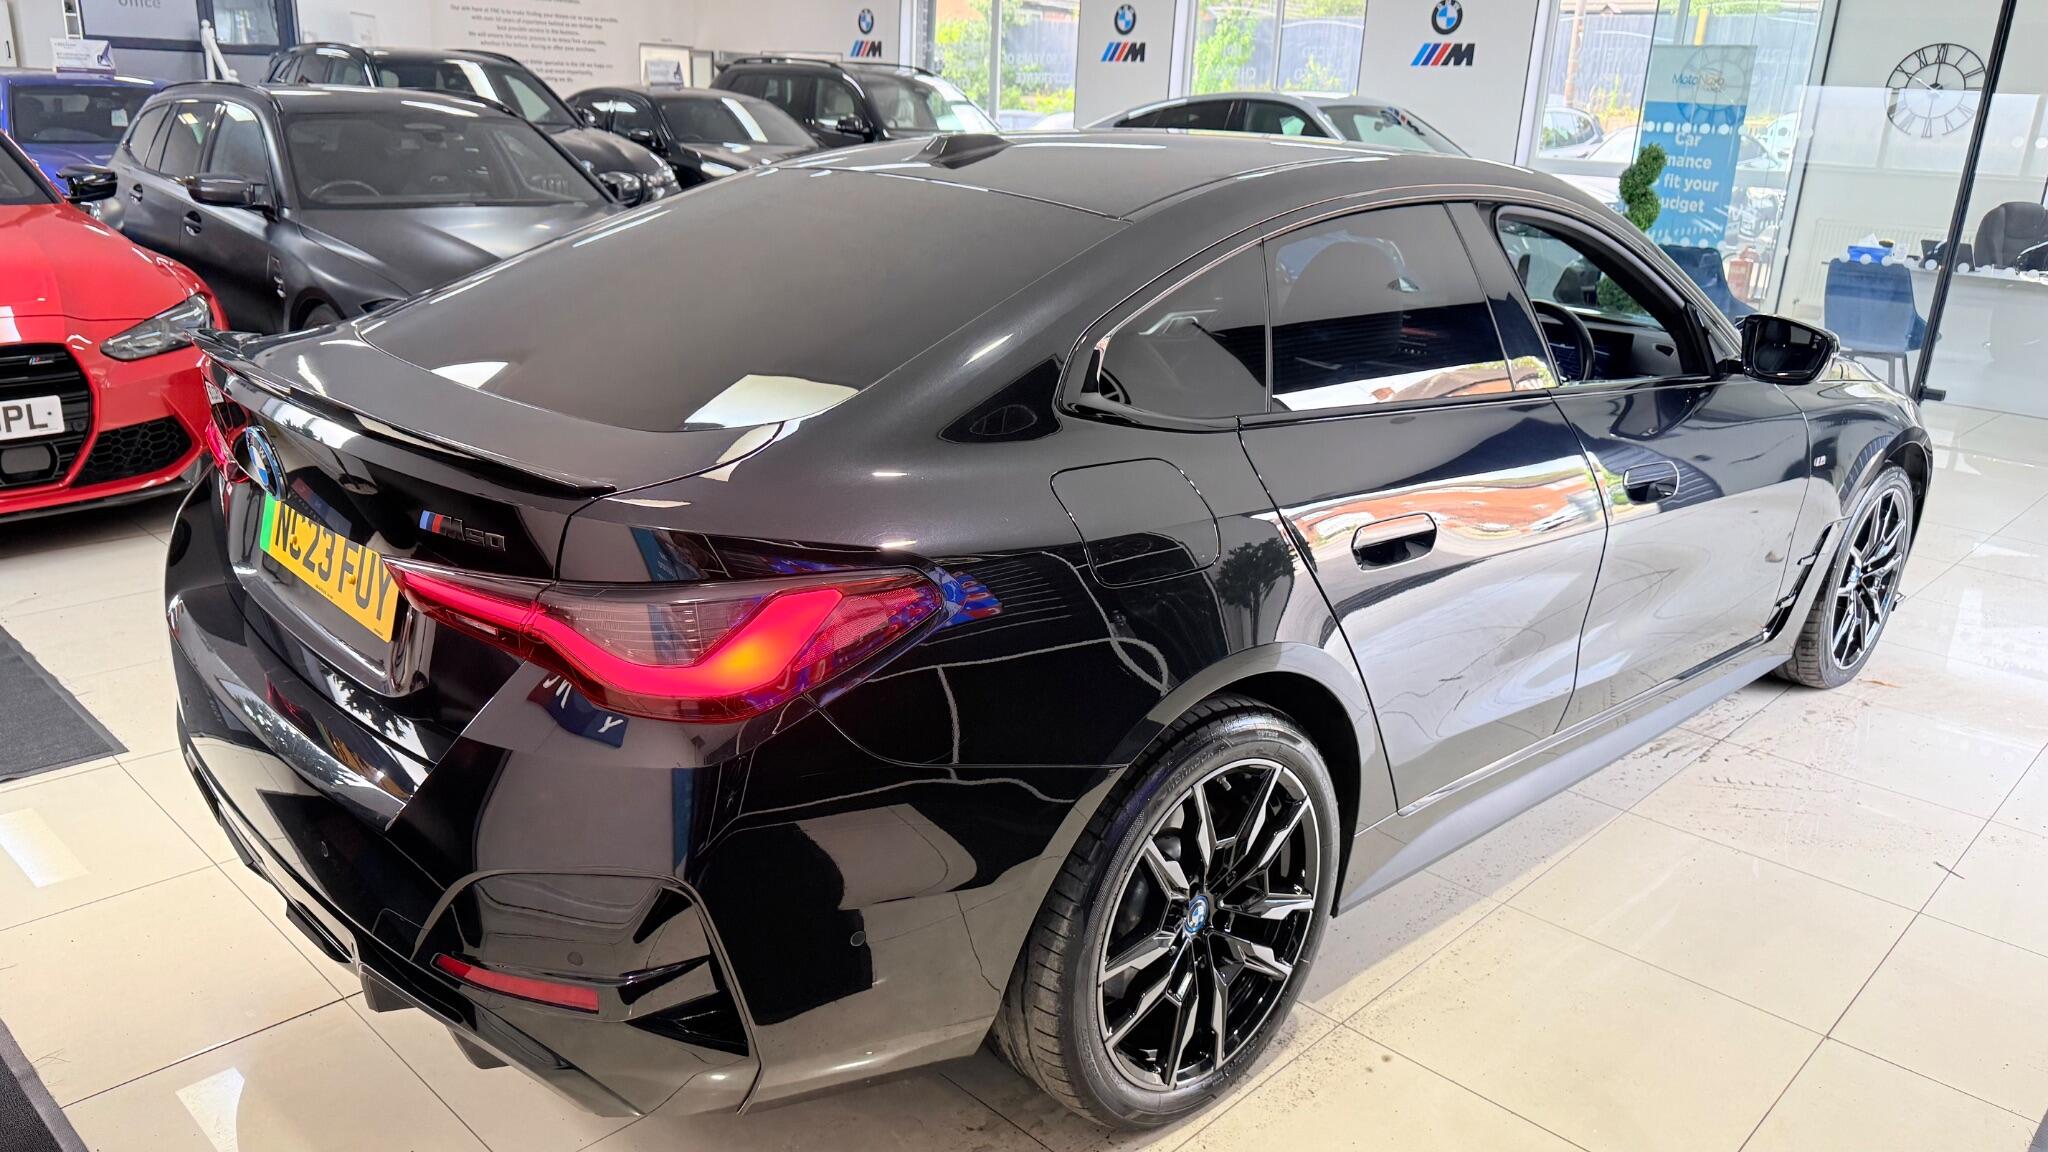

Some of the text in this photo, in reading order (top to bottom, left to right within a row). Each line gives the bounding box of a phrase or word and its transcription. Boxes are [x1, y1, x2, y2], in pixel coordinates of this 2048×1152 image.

[1440, 43, 1475, 66] M
[1675, 131, 1702, 147] Car
[1666, 154, 1713, 170] nance
[1664, 173, 1681, 188] fit
[1683, 179, 1720, 193] your
[1660, 196, 1705, 213] udget
[0, 404, 49, 433] PL
[275, 502, 337, 582] NC23
[337, 539, 392, 621] FUY
